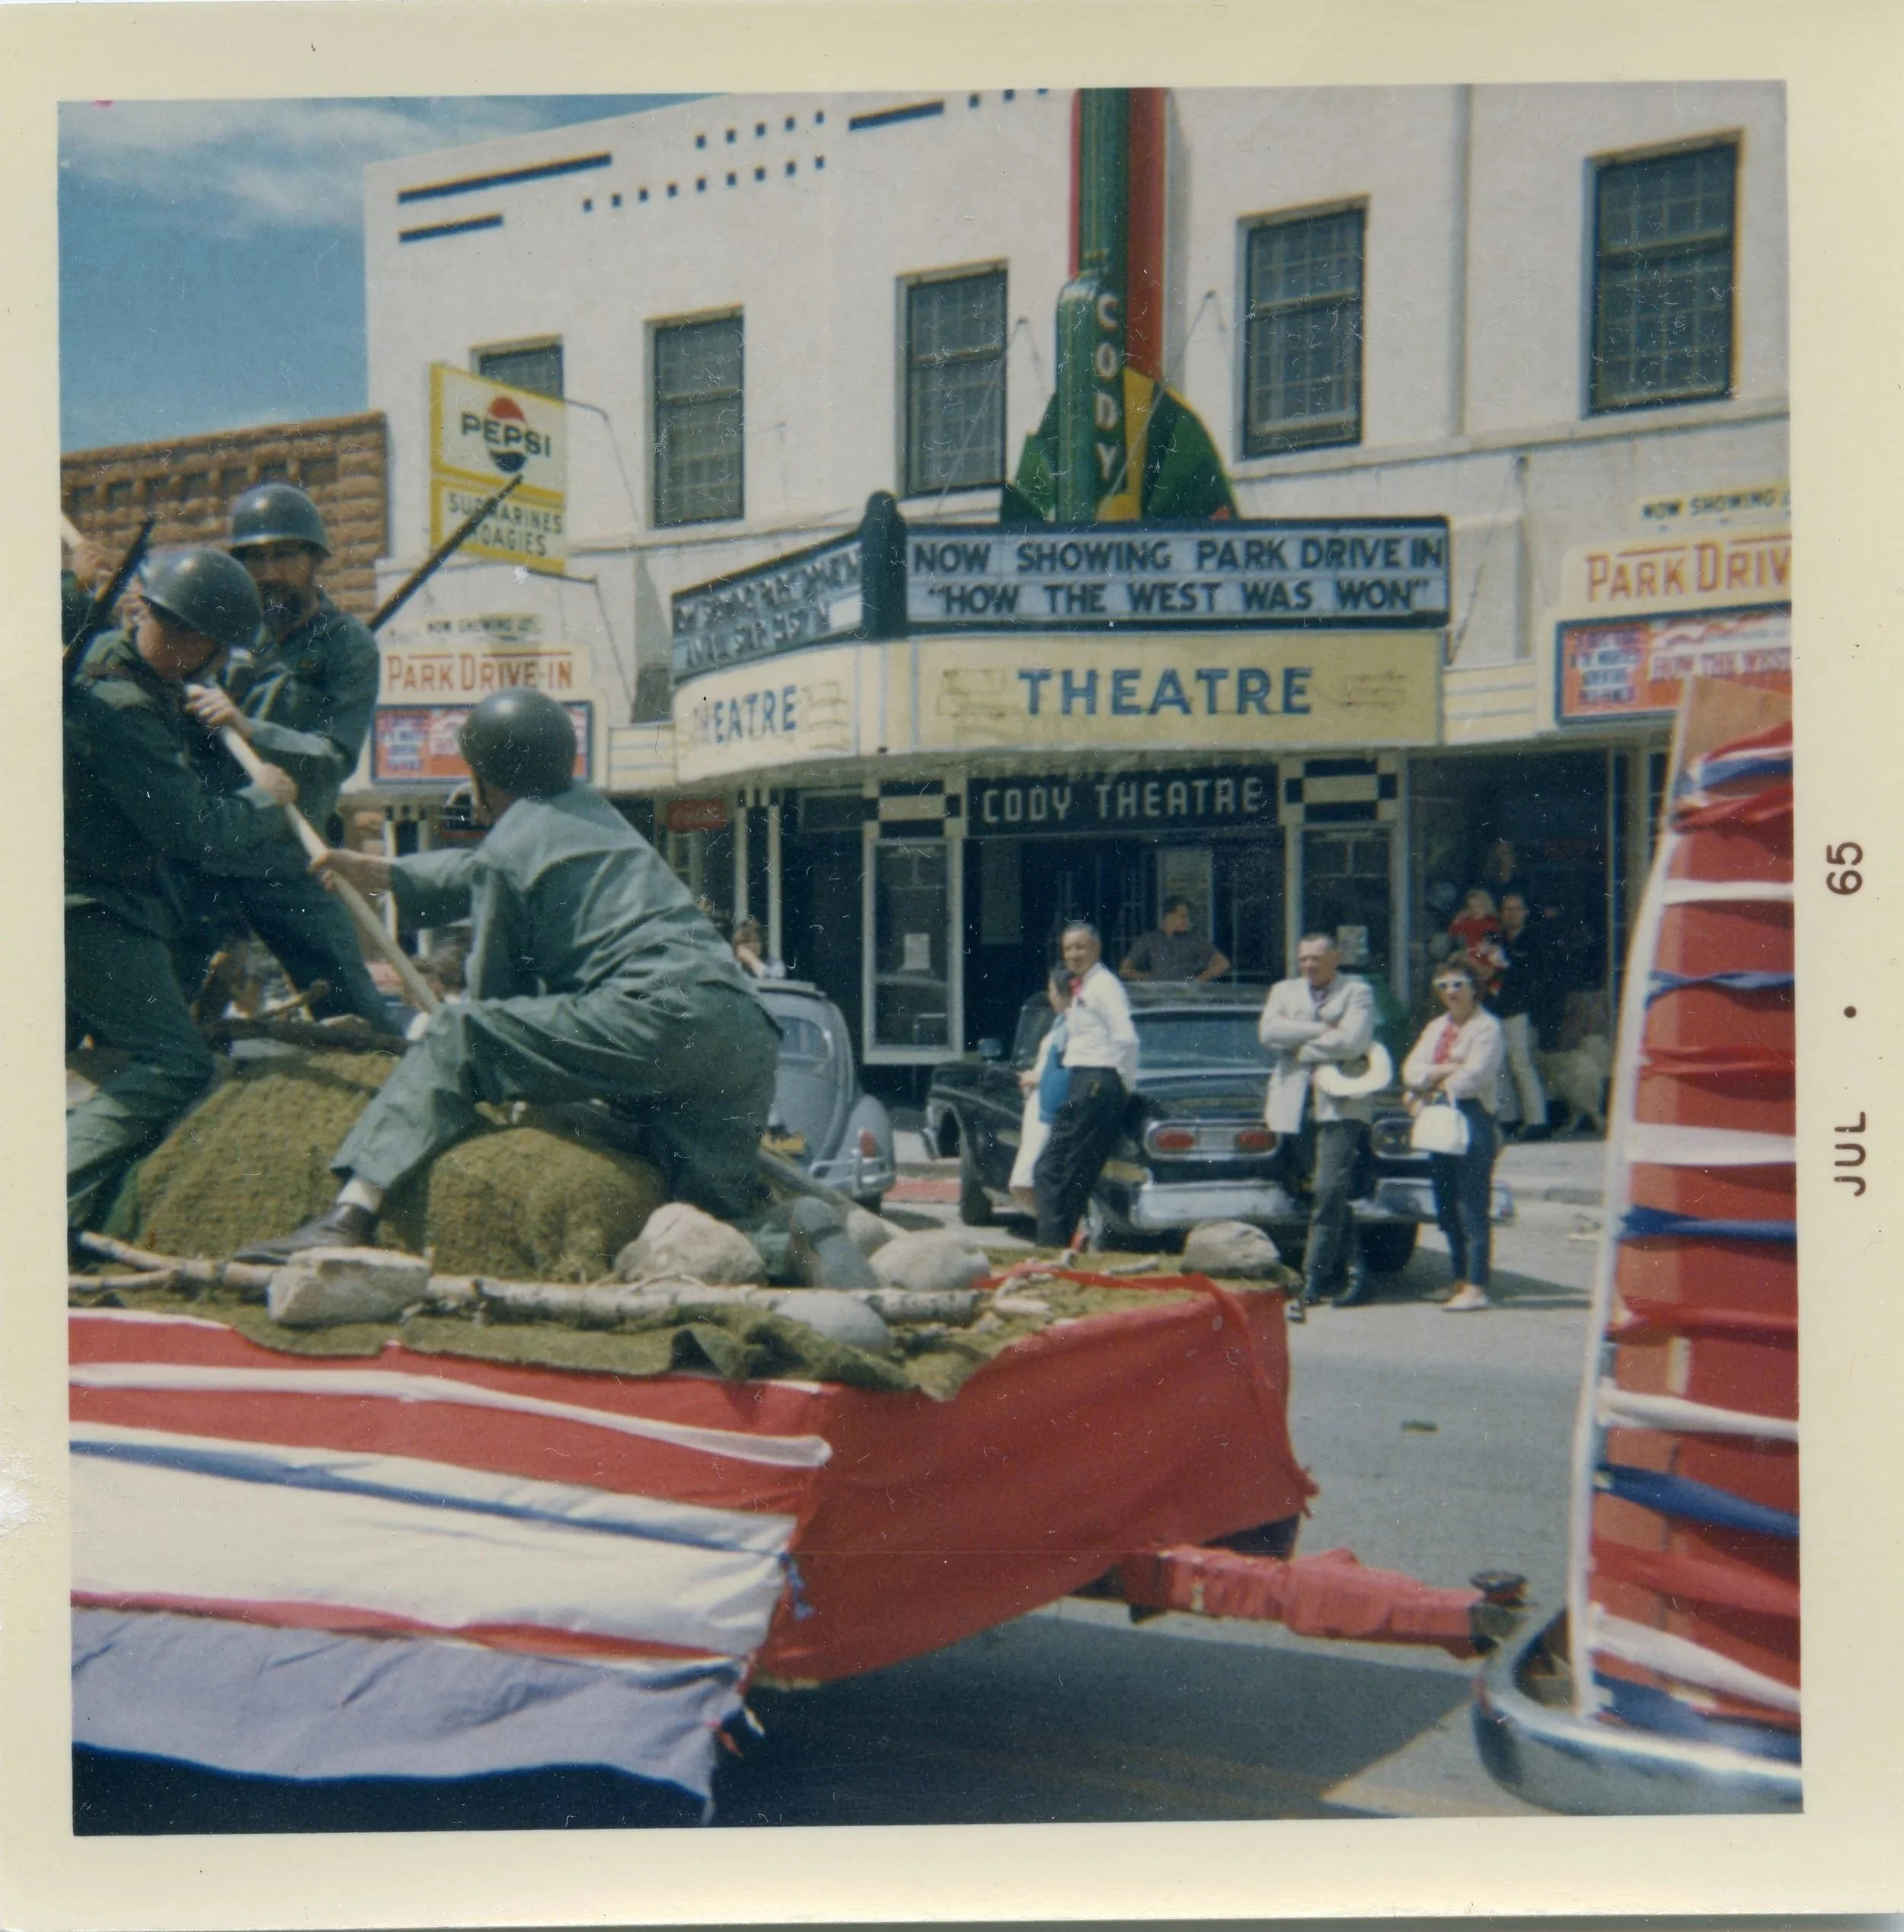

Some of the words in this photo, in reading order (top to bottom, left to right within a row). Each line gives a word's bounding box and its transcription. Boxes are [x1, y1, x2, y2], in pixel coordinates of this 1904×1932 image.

[1096, 292, 1119, 481] CODY
[460, 411, 551, 458] PEPSI
[448, 491, 564, 535] SUARINES
[914, 541, 992, 572] NOW
[1016, 540, 1171, 572] SHOWING
[1196, 538, 1287, 570] PARK
[1299, 537, 1402, 569] DRIVE
[1410, 536, 1442, 568] IN
[1586, 553, 1685, 602] PARK
[927, 583, 1020, 614] "HOW
[1043, 583, 1107, 614] THE
[1127, 581, 1222, 614] WEST
[1240, 580, 1312, 611] WAS
[1335, 579, 1431, 610] WON"
[387, 653, 455, 691] PARK
[459, 652, 573, 691] DRIVE-IN
[1017, 666, 1312, 717] THEATRE
[982, 785, 1071, 824] CODY
[1094, 776, 1262, 819] THEATRE
